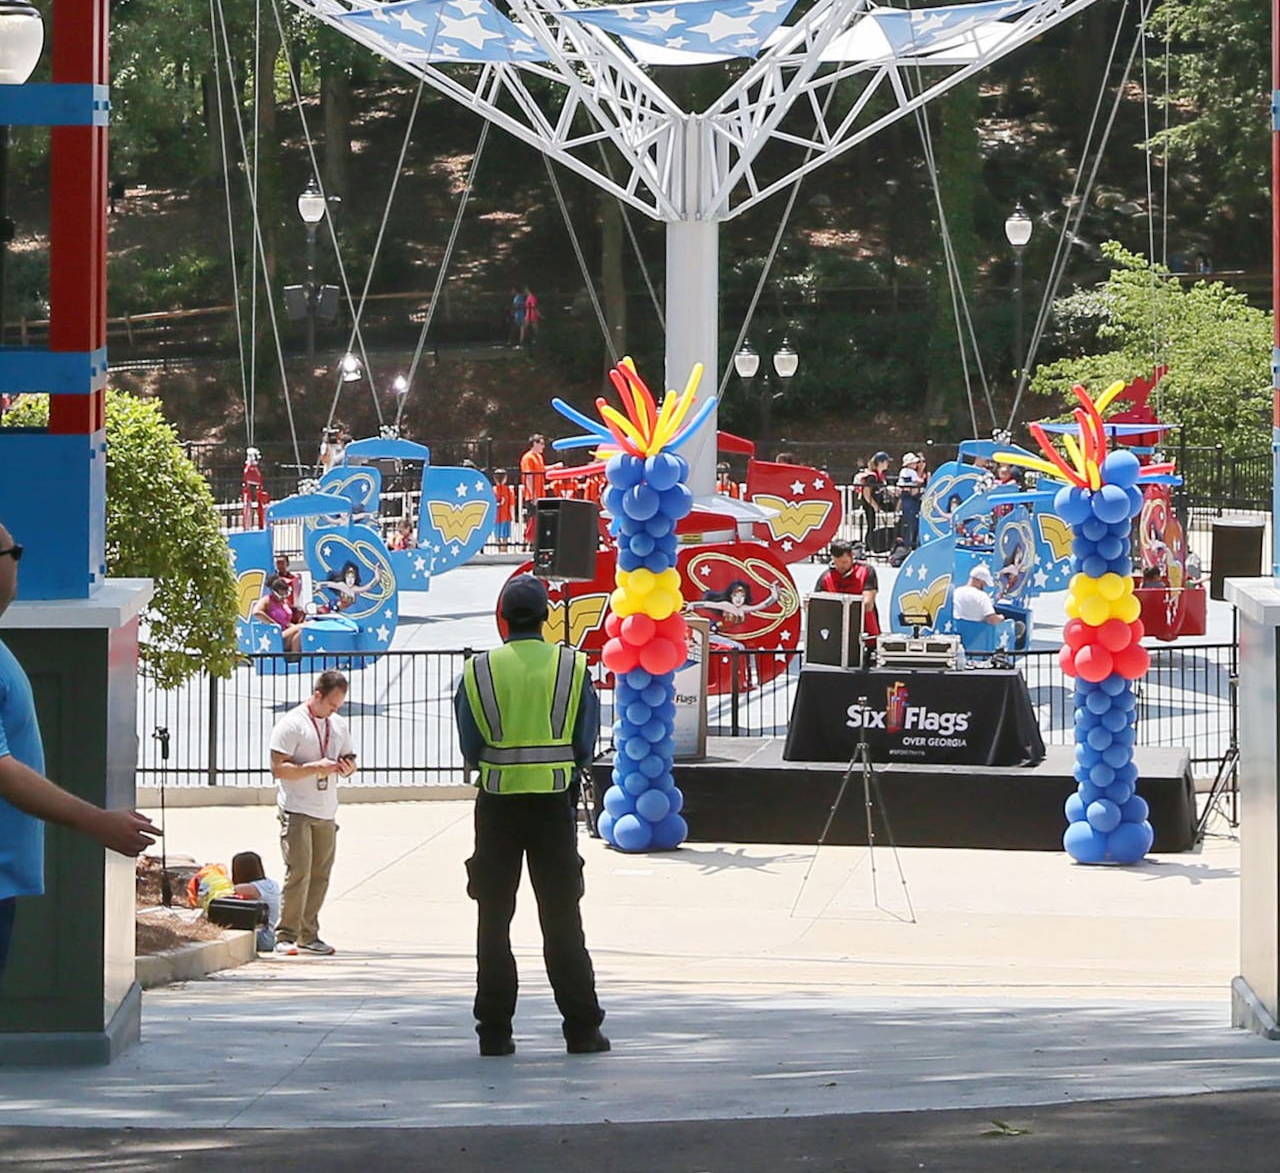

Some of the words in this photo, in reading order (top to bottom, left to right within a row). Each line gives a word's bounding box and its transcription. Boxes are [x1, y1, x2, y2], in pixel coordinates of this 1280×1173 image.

[676, 694, 697, 704] Flags
[846, 704, 886, 728] Six
[904, 707, 969, 735] Flags
[902, 736, 926, 747] OVER
[927, 737, 967, 747] GEORGIA
